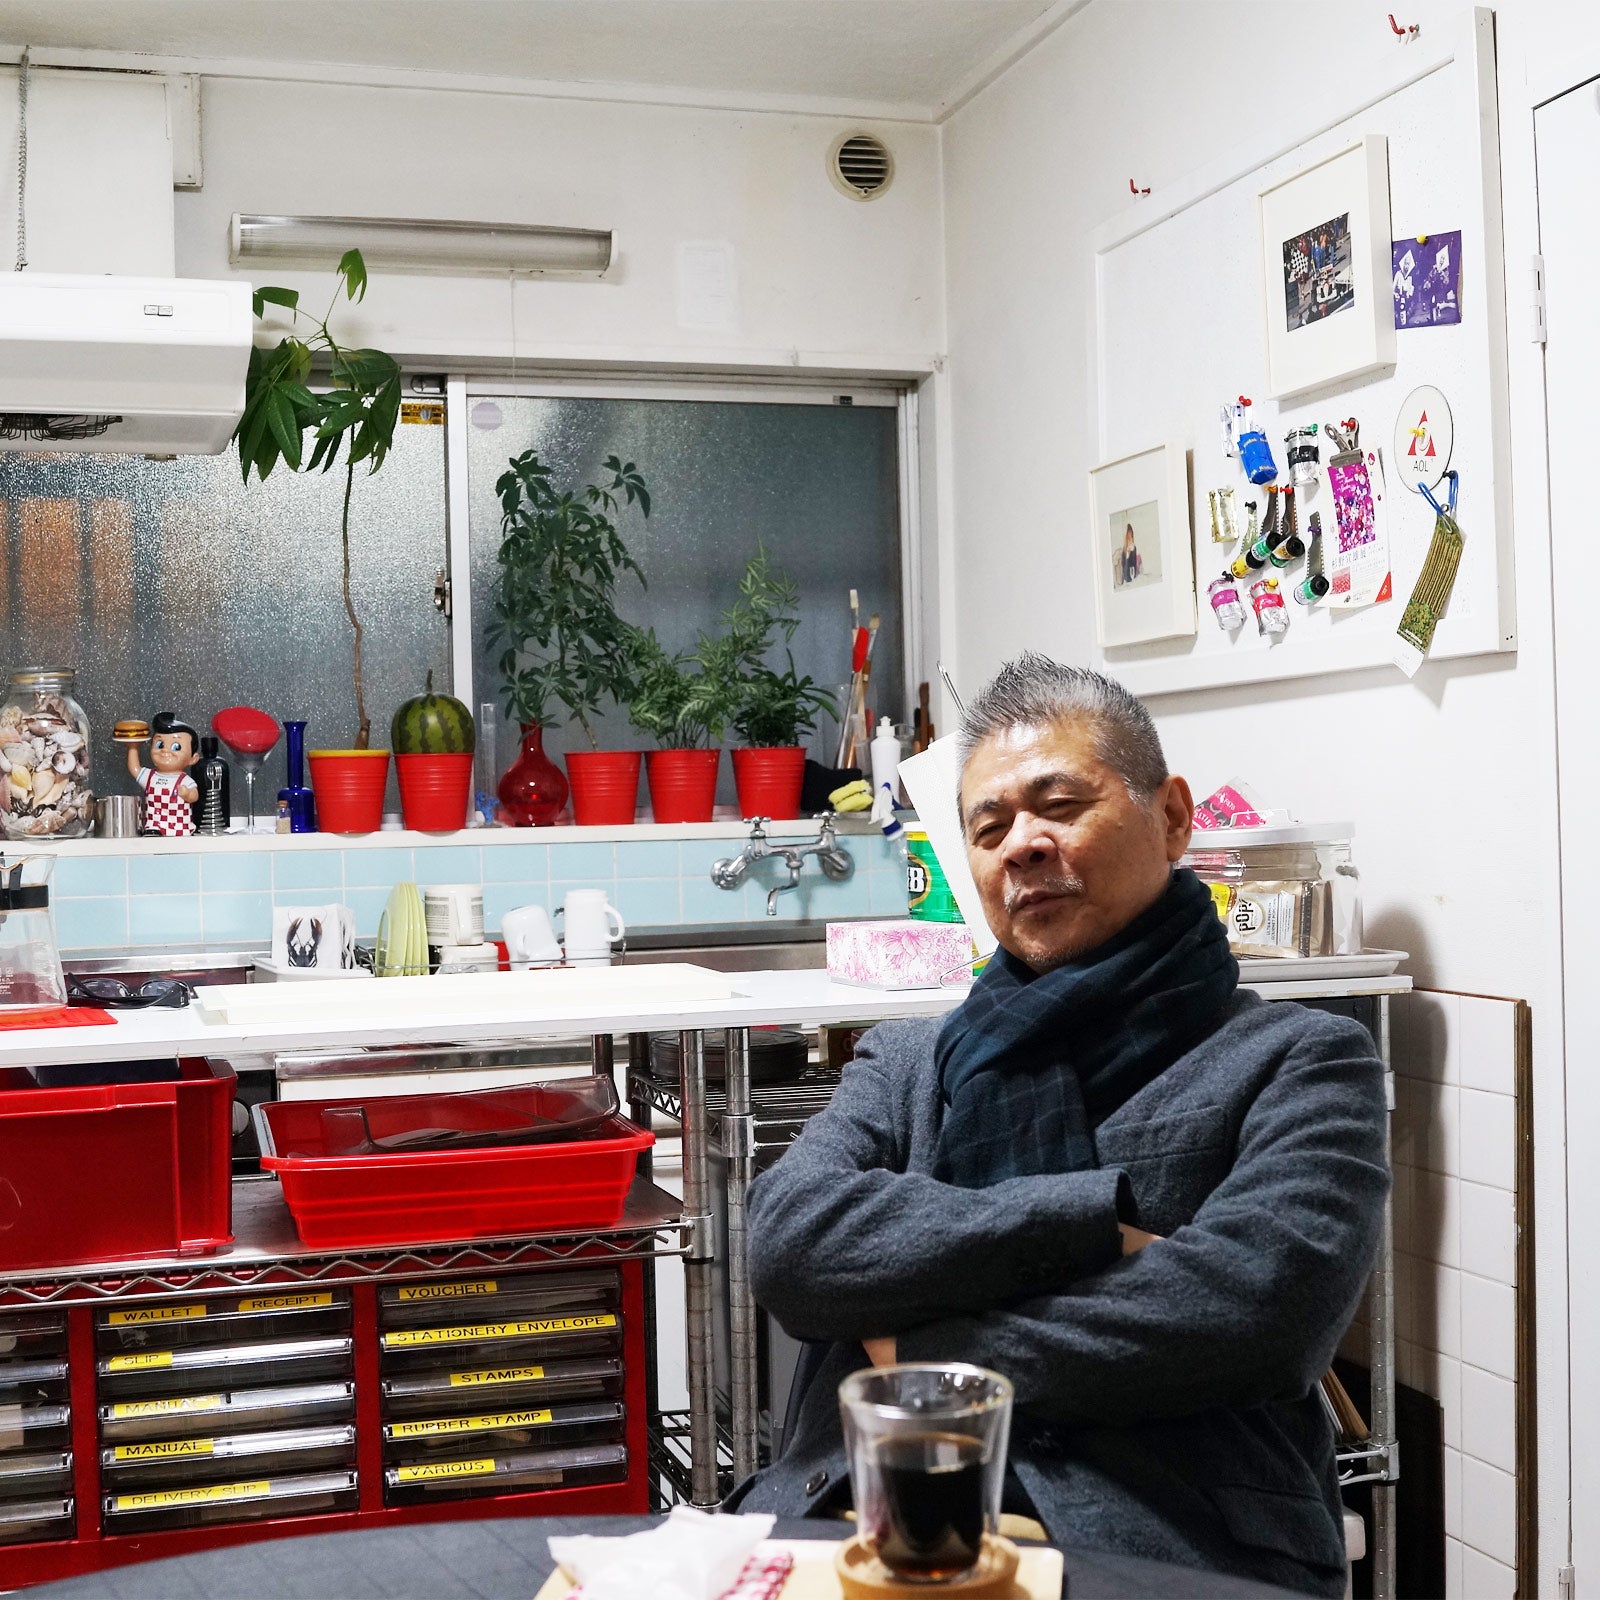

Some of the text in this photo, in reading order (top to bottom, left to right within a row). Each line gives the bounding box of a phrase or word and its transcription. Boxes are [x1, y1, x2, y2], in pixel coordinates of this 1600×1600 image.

[1413, 459, 1429, 472] AOL
[405, 1283, 488, 1299] VOUCHER
[252, 1295, 320, 1309] RECEIPT
[123, 1307, 193, 1321] WALLET
[397, 1316, 606, 1342] STATIONERY ENVELOPE
[123, 1354, 160, 1365] SLIP
[461, 1368, 534, 1383] STAMPS
[402, 1411, 542, 1434] RUBBER STAMP
[125, 1441, 203, 1456] MANUAL
[409, 1461, 486, 1477] VARIOUS
[131, 1483, 258, 1506] DELIVERY SLIP
